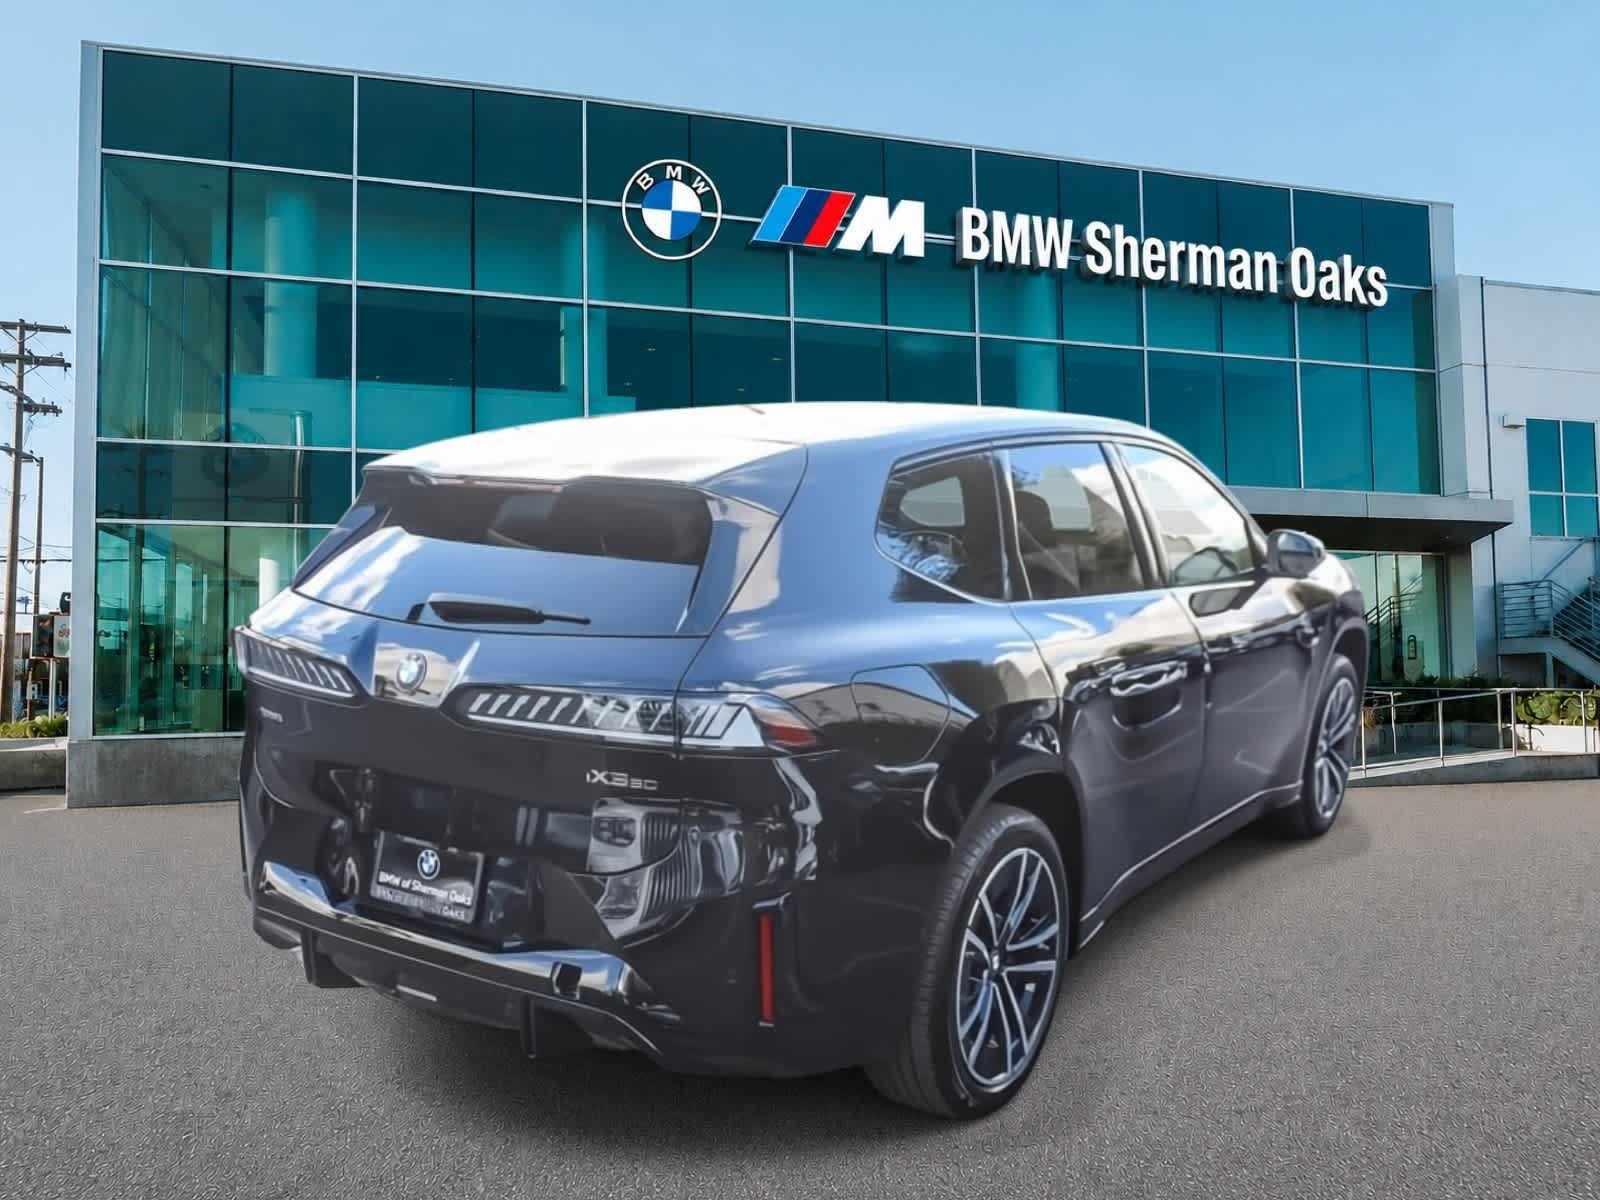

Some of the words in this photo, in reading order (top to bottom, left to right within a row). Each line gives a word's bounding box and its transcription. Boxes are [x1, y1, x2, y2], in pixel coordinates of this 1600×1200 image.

[636, 164, 711, 196] BMW
[836, 194, 926, 258] M
[960, 206, 1074, 270] BMW
[1083, 221, 1279, 294] Sherman
[1289, 246, 1390, 308] Oaks
